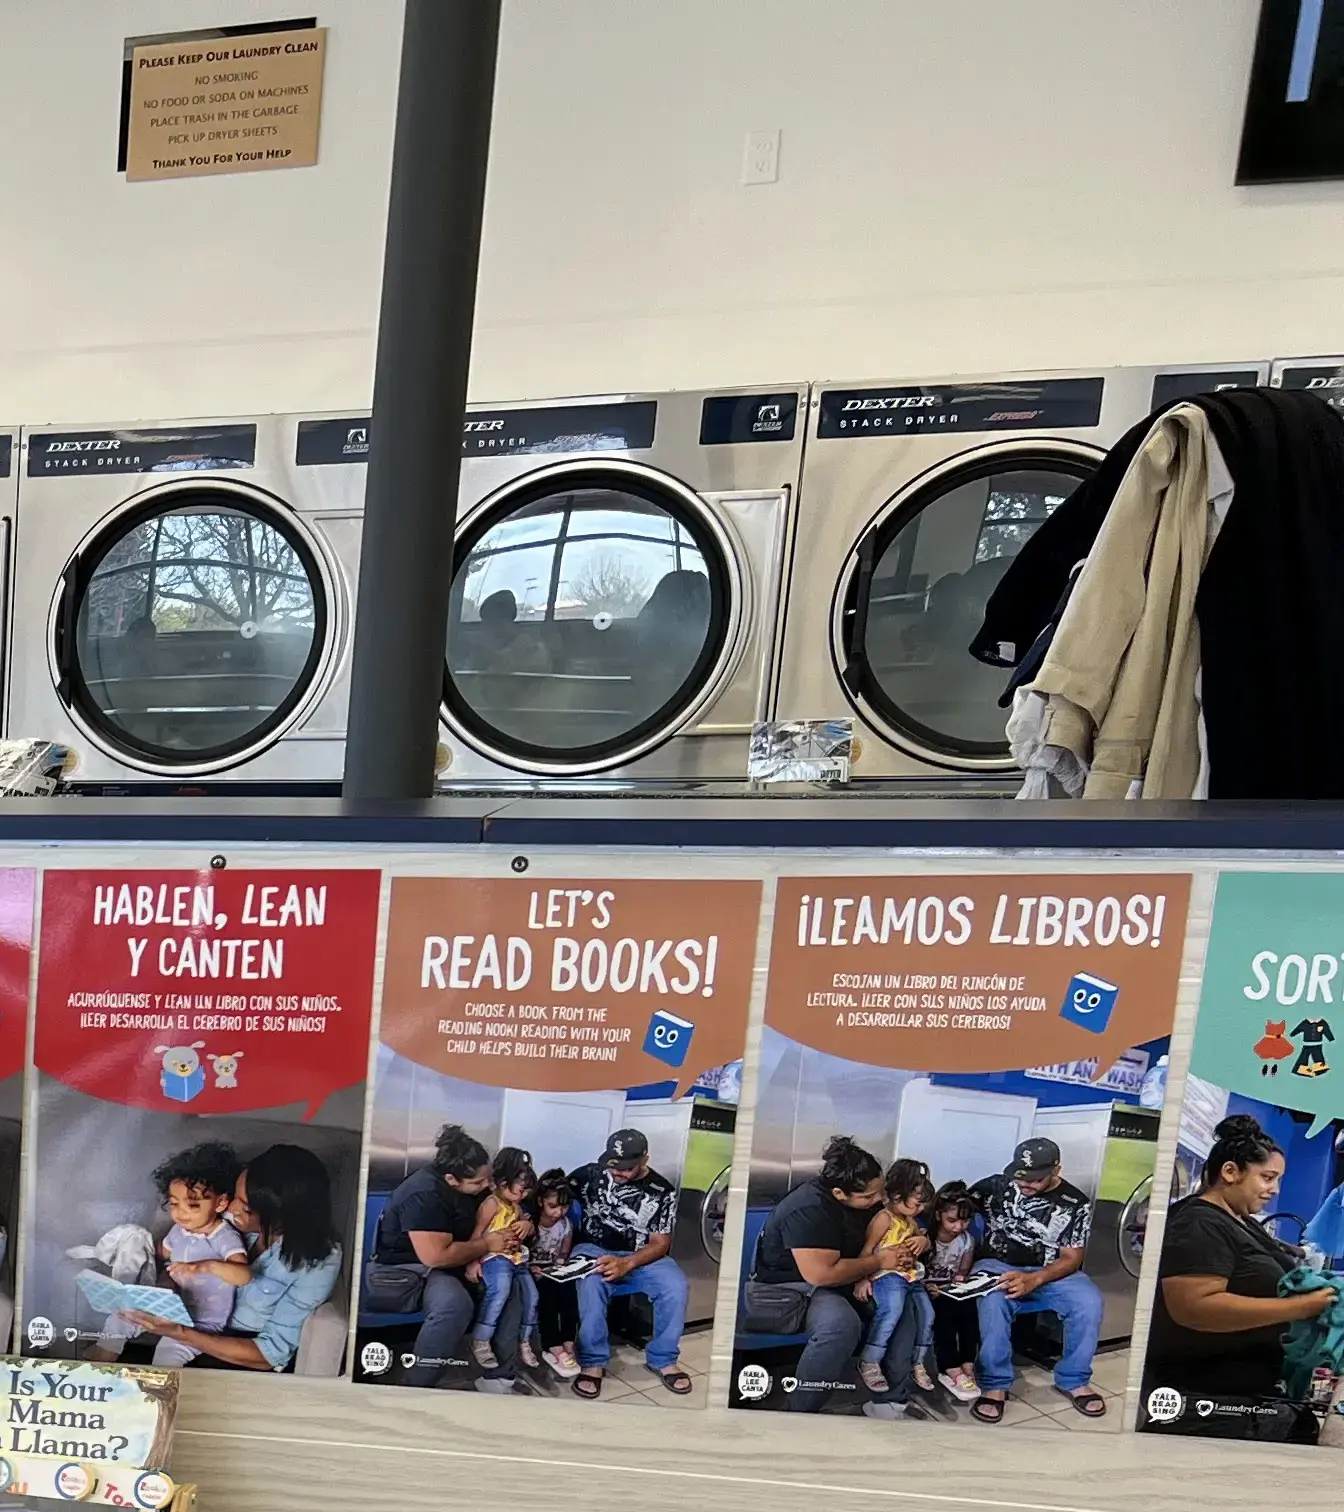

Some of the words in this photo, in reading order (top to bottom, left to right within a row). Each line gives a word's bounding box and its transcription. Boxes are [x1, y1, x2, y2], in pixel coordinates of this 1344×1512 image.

[139, 58, 174, 68] PLEASE
[178, 54, 203, 65] KEEP
[206, 52, 230, 62] OUR
[233, 46, 281, 58] LAUNDRY
[284, 42, 318, 53] CLEAN
[195, 76, 210, 85] NO
[213, 71, 258, 83] SMOKING
[144, 100, 158, 109] NO
[162, 97, 189, 108] FOOD
[192, 96, 206, 105] OR
[209, 92, 236, 103] SODA
[240, 91, 255, 100] ON
[258, 85, 309, 98] MACHINES
[153, 158, 187, 169] THANK
[189, 155, 210, 165] YOU
[213, 154, 233, 163] FOR
[235, 151, 263, 162] YOUR
[266, 149, 292, 159] HELP
[842, 396, 936, 411] DEXTER
[839, 416, 894, 429] STACK
[905, 414, 959, 426] DRYER
[45, 439, 121, 453] DEXTER
[92, 885, 227, 930] HABLEN,
[241, 886, 326, 927] LEAN
[528, 890, 615, 929] LET'S
[798, 894, 974, 947] ¡LEAMOS
[989, 893, 1167, 948] LIBROS!
[127, 939, 147, 977] Y
[158, 938, 284, 979] CANTEN
[420, 935, 532, 990] READ
[551, 936, 718, 997] BOOKS!
[1244, 951, 1344, 1005] SOR
[465, 1003, 505, 1018] CHOOSE
[508, 1005, 515, 1018] A
[519, 1005, 548, 1019] BOOK
[552, 1007, 583, 1021] FROM
[587, 1008, 607, 1023] THE
[7, 1371, 35, 1396] Is
[43, 1372, 114, 1403] Your
[7, 1399, 106, 1430] Mama
[9, 1427, 129, 1462] Llama?
